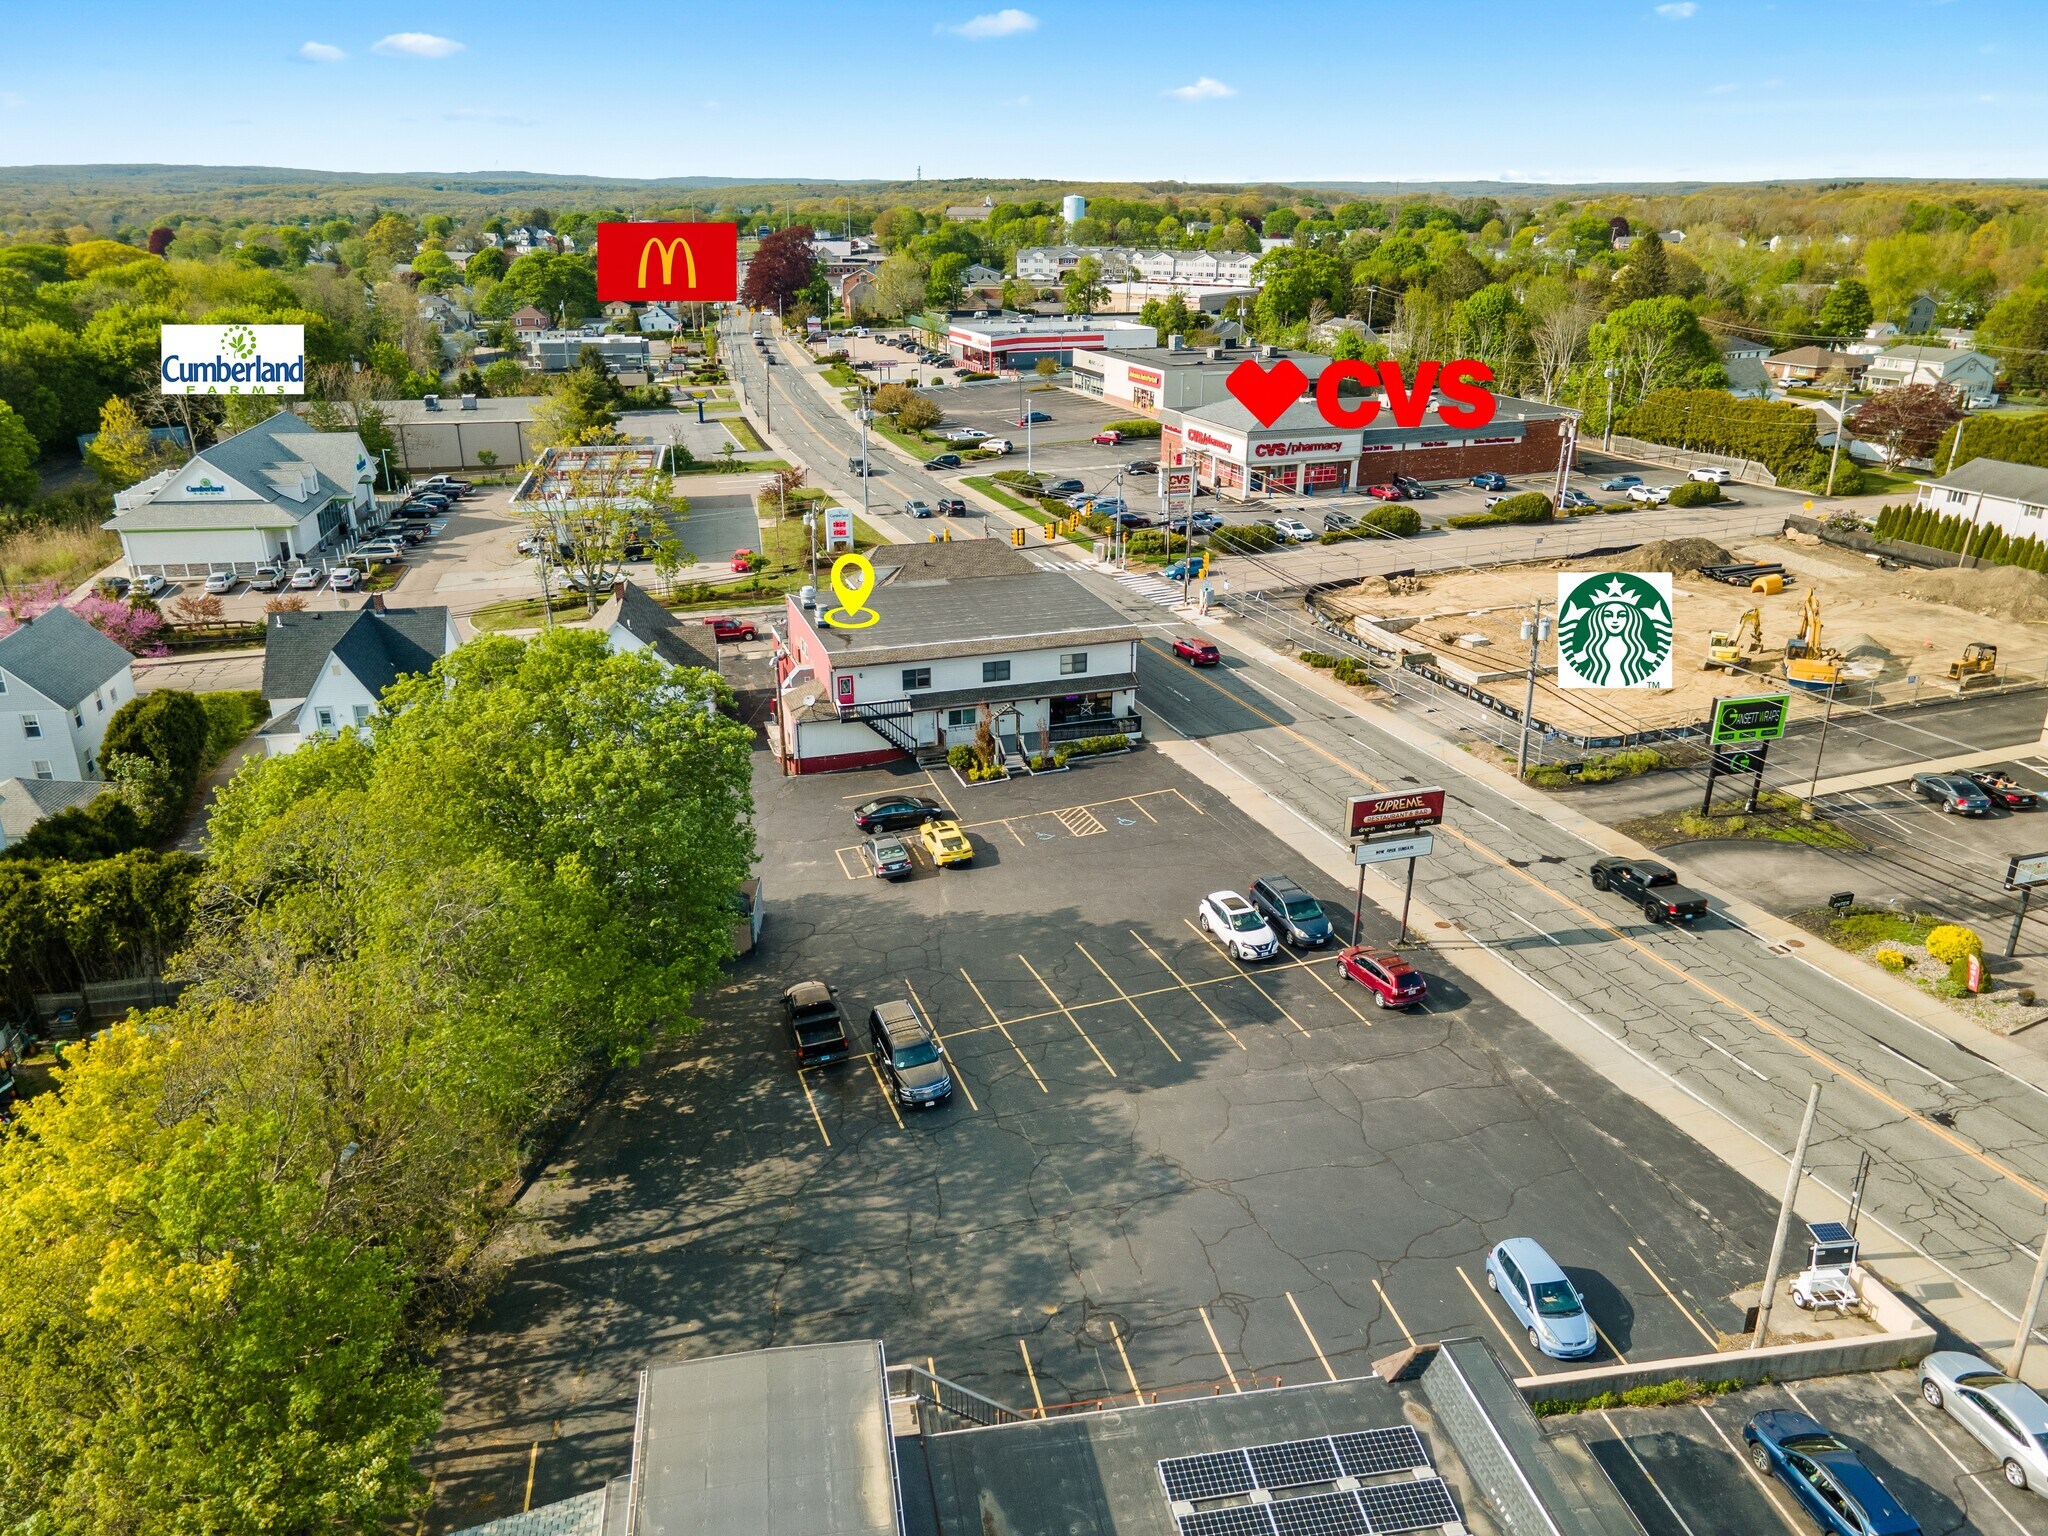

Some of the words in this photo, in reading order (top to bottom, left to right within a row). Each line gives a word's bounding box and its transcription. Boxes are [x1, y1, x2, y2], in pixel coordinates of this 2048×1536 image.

[1255, 442, 1342, 457] CVS/pharmacy
[1169, 474, 1190, 485] CVS
[1372, 796, 1425, 813] SUPREME
[1367, 812, 1408, 822] RESTAURANT
[1414, 808, 1428, 816] BAR
[1414, 818, 1435, 826] delivery
